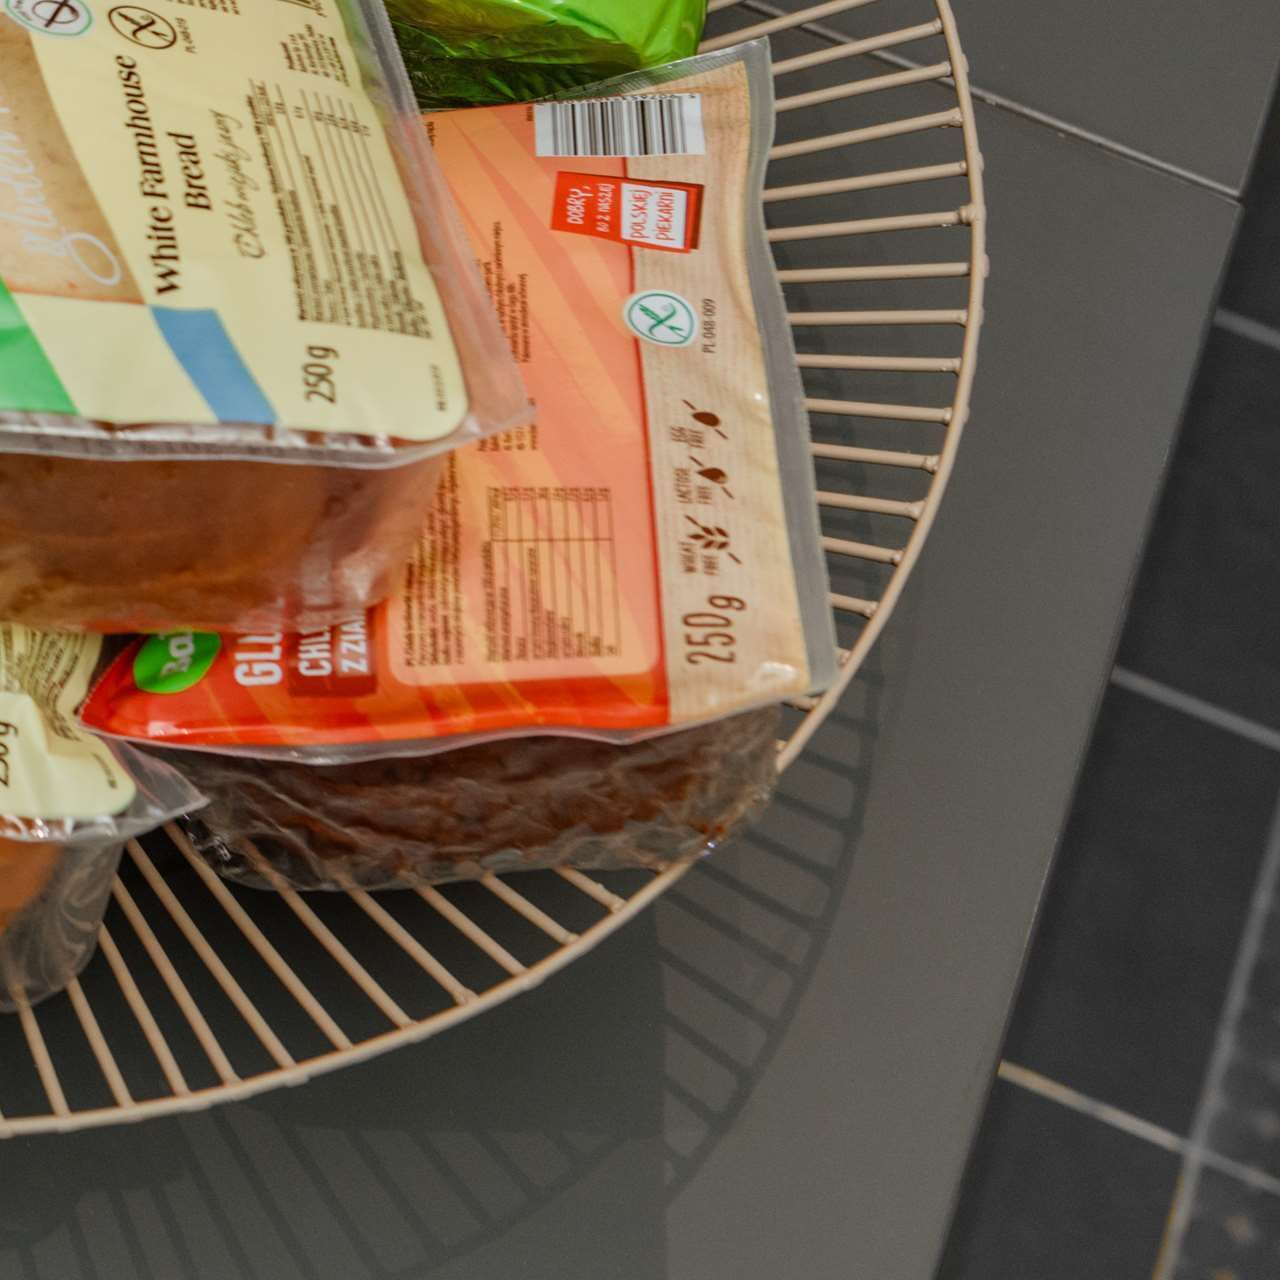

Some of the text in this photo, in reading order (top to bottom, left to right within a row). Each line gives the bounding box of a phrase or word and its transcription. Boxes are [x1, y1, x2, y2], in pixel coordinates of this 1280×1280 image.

[116, 55, 181, 296] White Farmhouse
[165, 130, 213, 211] Bread
[566, 185, 593, 225] DOBRY,
[302, 344, 340, 404] 250 g
